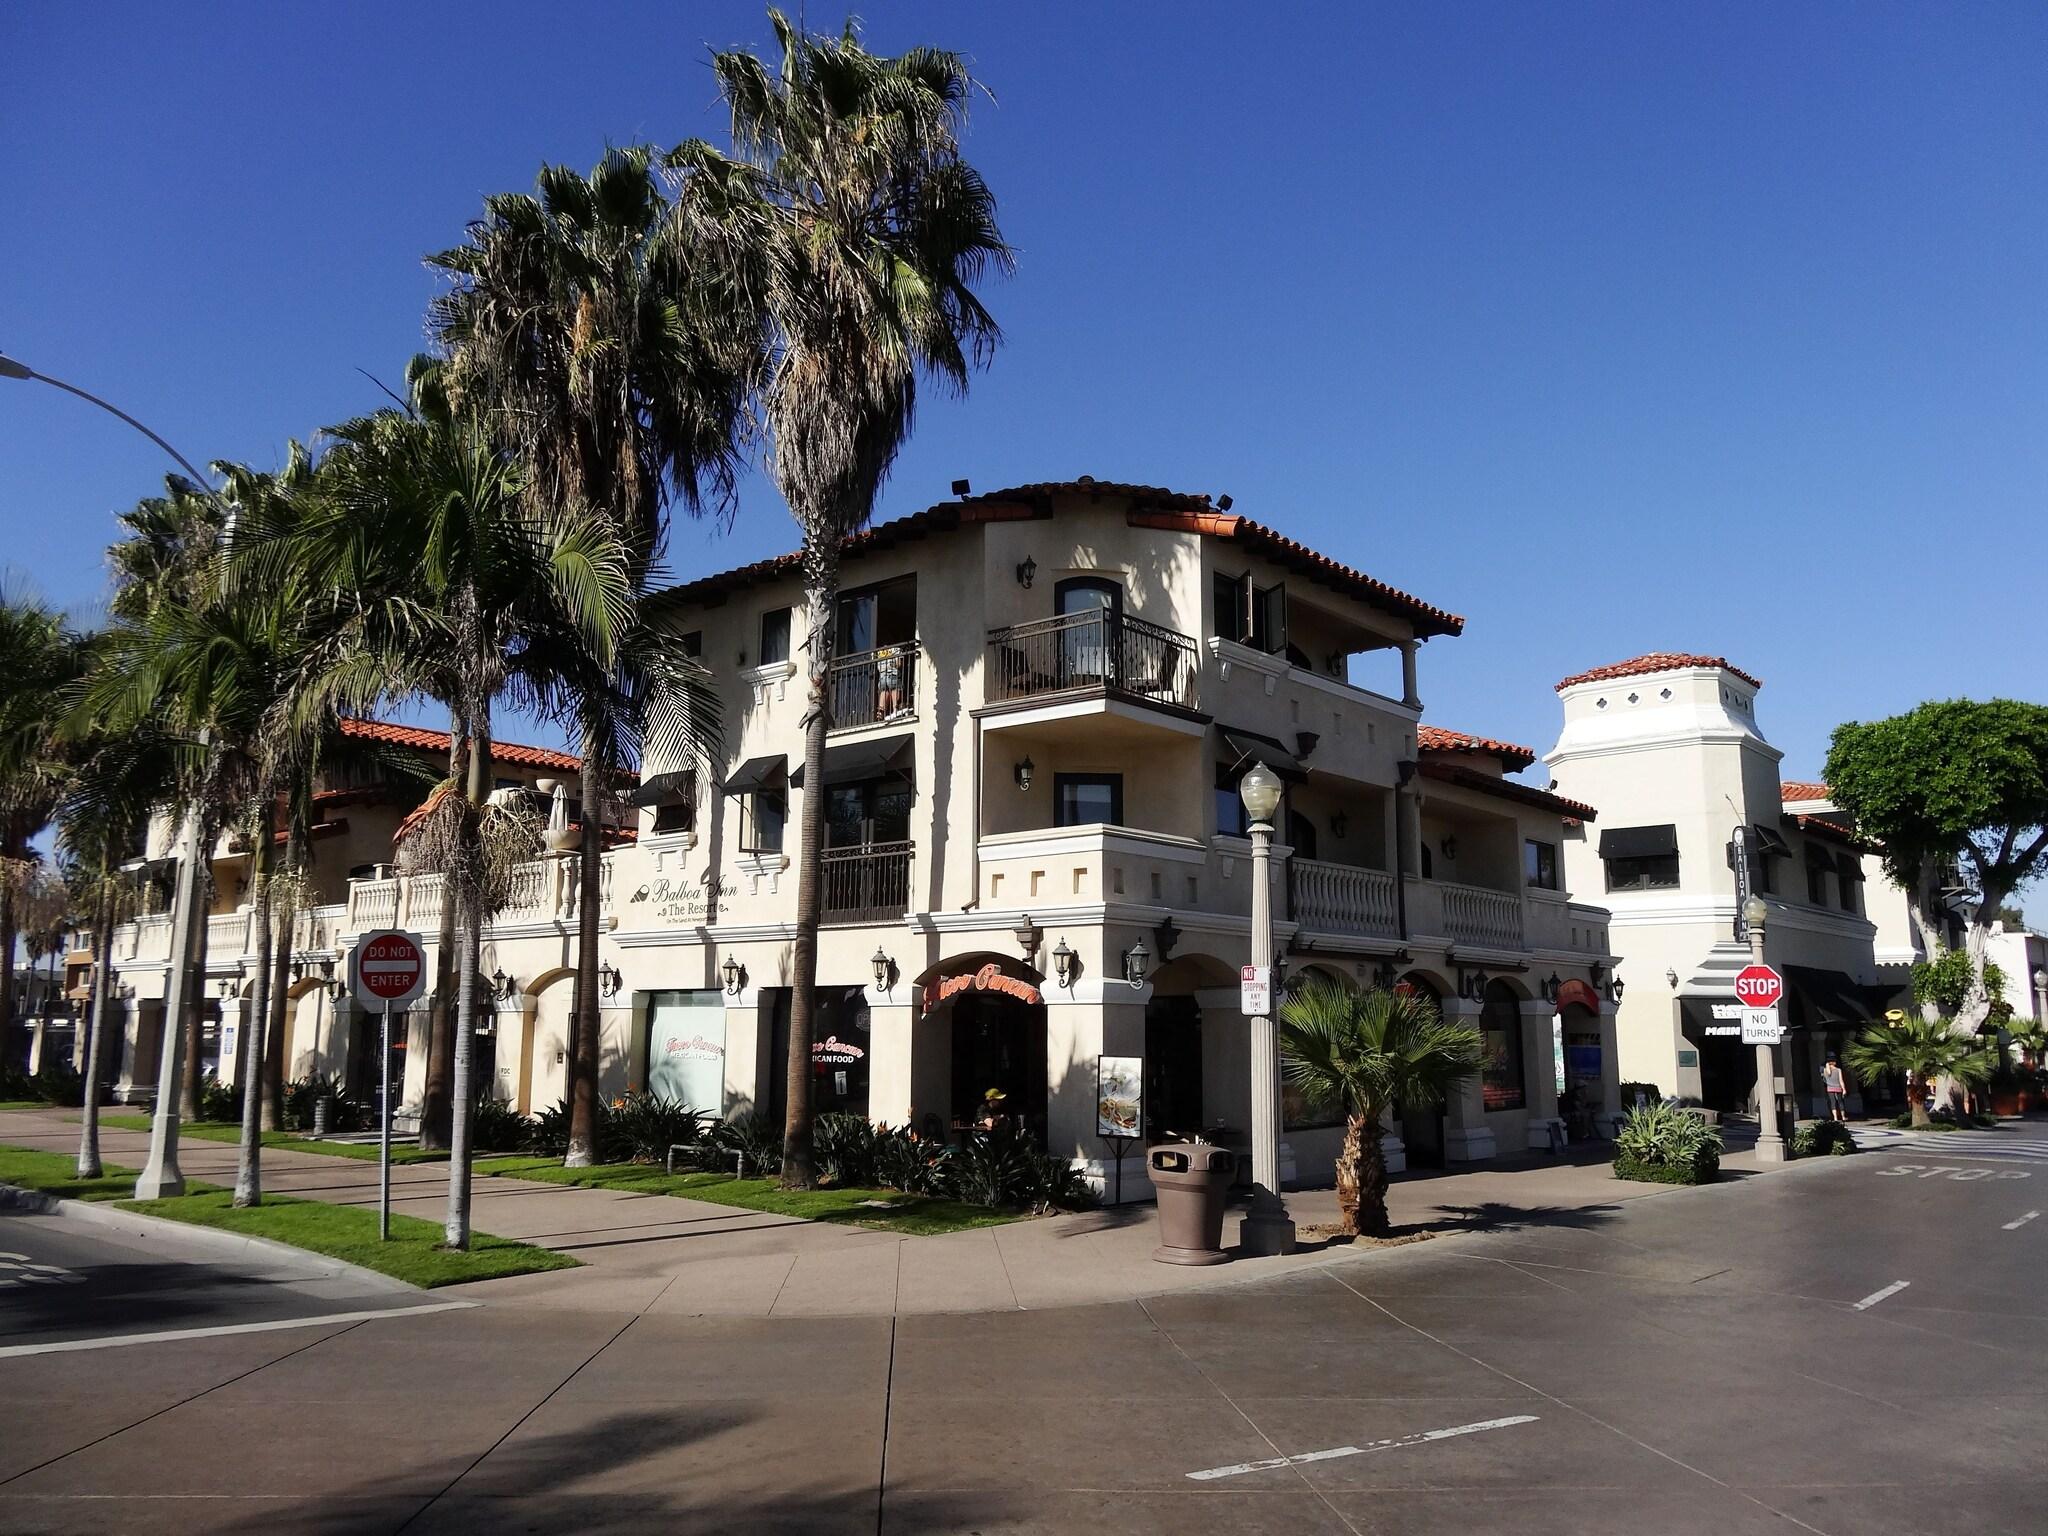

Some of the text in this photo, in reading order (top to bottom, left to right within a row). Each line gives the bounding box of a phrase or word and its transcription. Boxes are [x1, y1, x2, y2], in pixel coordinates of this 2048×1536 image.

[1737, 846, 1745, 897] BALBOA
[652, 874, 738, 903] Balboa Inn
[668, 902, 717, 916] The Resort
[370, 946, 413, 958] DO NOT
[1243, 968, 1254, 980] NO
[371, 975, 410, 986] ENTER
[975, 963, 1039, 1005] Cancun
[1738, 978, 1779, 995] STOP
[1243, 982, 1268, 992] STOPPING
[1250, 1001, 1262, 1009] TIME
[1752, 1014, 1767, 1024] NO
[1705, 1027, 1741, 1036] MAIN
[1745, 1029, 1776, 1038] TURNS
[825, 1036, 865, 1058] Cancun
[812, 1055, 854, 1063] ICAN FOOD
[1875, 1165, 2032, 1181] STOP
